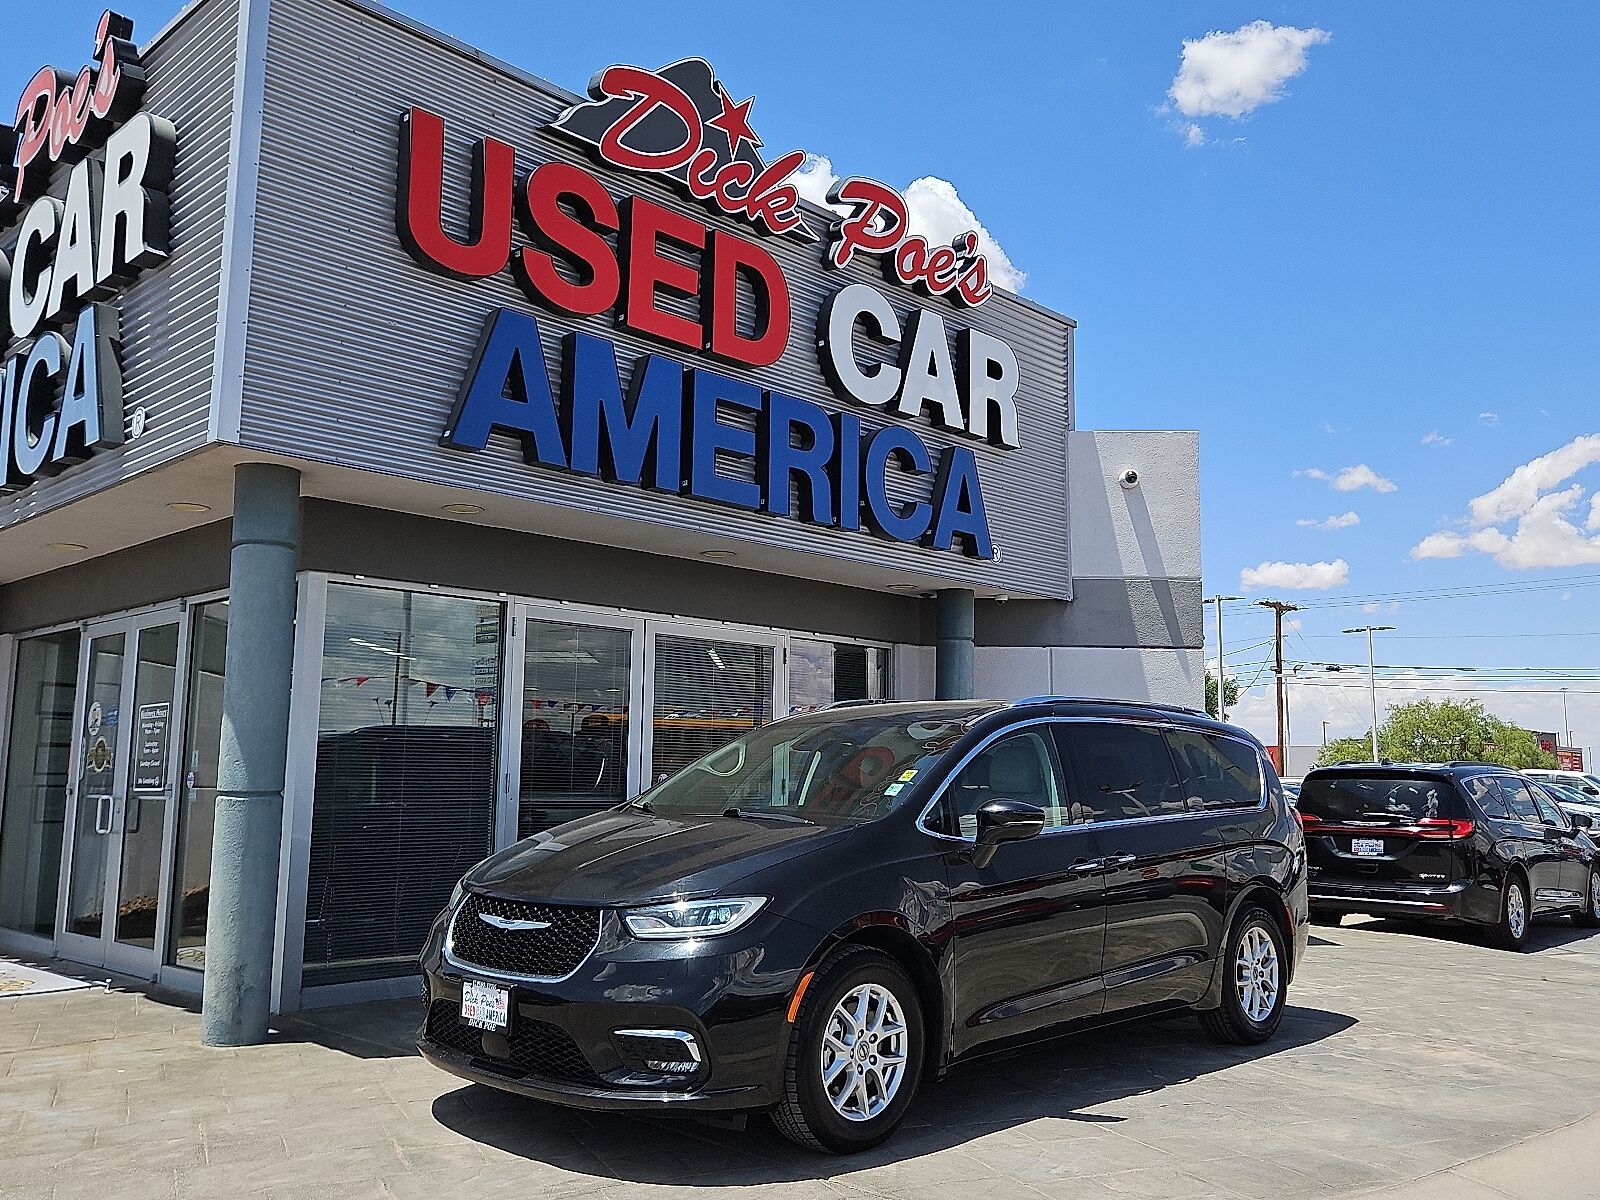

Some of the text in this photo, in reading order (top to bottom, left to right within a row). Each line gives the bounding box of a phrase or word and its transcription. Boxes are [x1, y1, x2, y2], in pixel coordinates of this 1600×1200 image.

[13, 9, 123, 203] Poe's
[599, 63, 993, 308] Dick Poe's
[9, 111, 156, 338] CAR
[403, 106, 1021, 449] USED CAR
[0, 304, 100, 487] ICA
[446, 307, 993, 561] AMERICA
[468, 1019, 497, 1031] DICK POE
